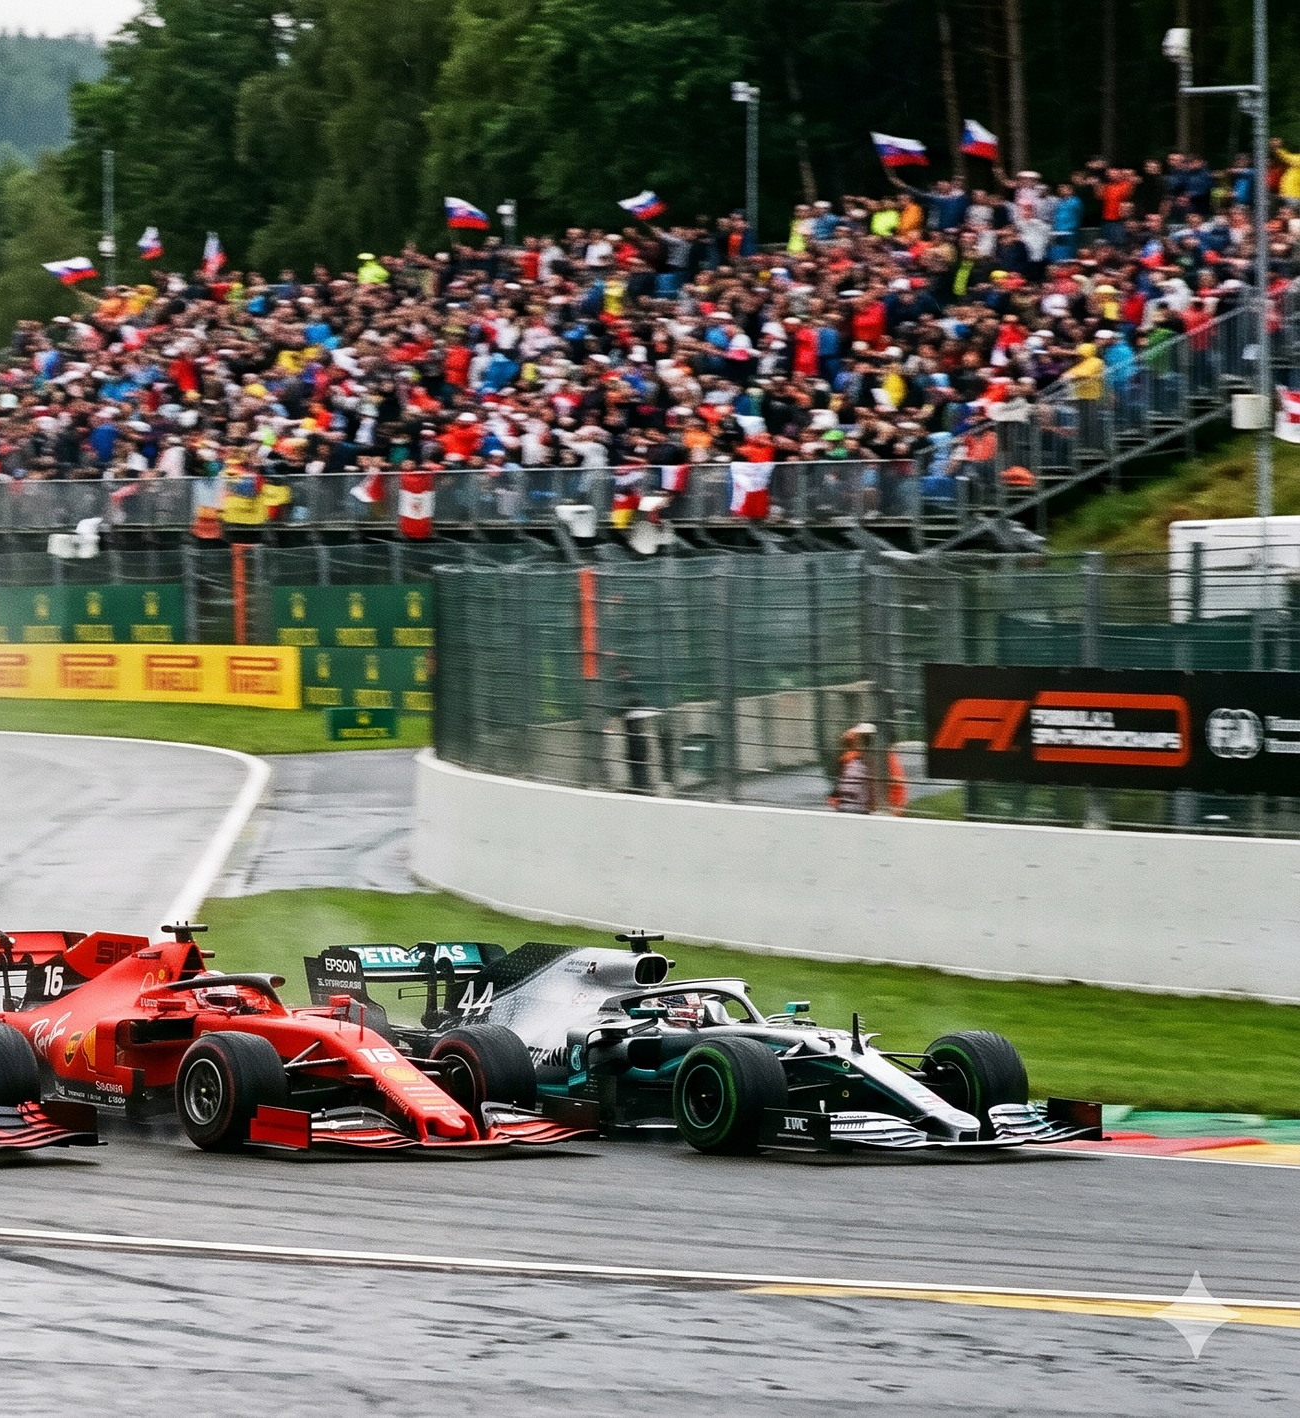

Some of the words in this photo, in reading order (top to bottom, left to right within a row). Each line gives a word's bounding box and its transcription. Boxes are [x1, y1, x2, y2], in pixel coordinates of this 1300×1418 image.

[325, 958, 356, 973] EPSON
[43, 965, 64, 996] 16
[457, 980, 494, 1018] 44
[357, 1048, 397, 1063] 16
[783, 1116, 808, 1131] IWC
